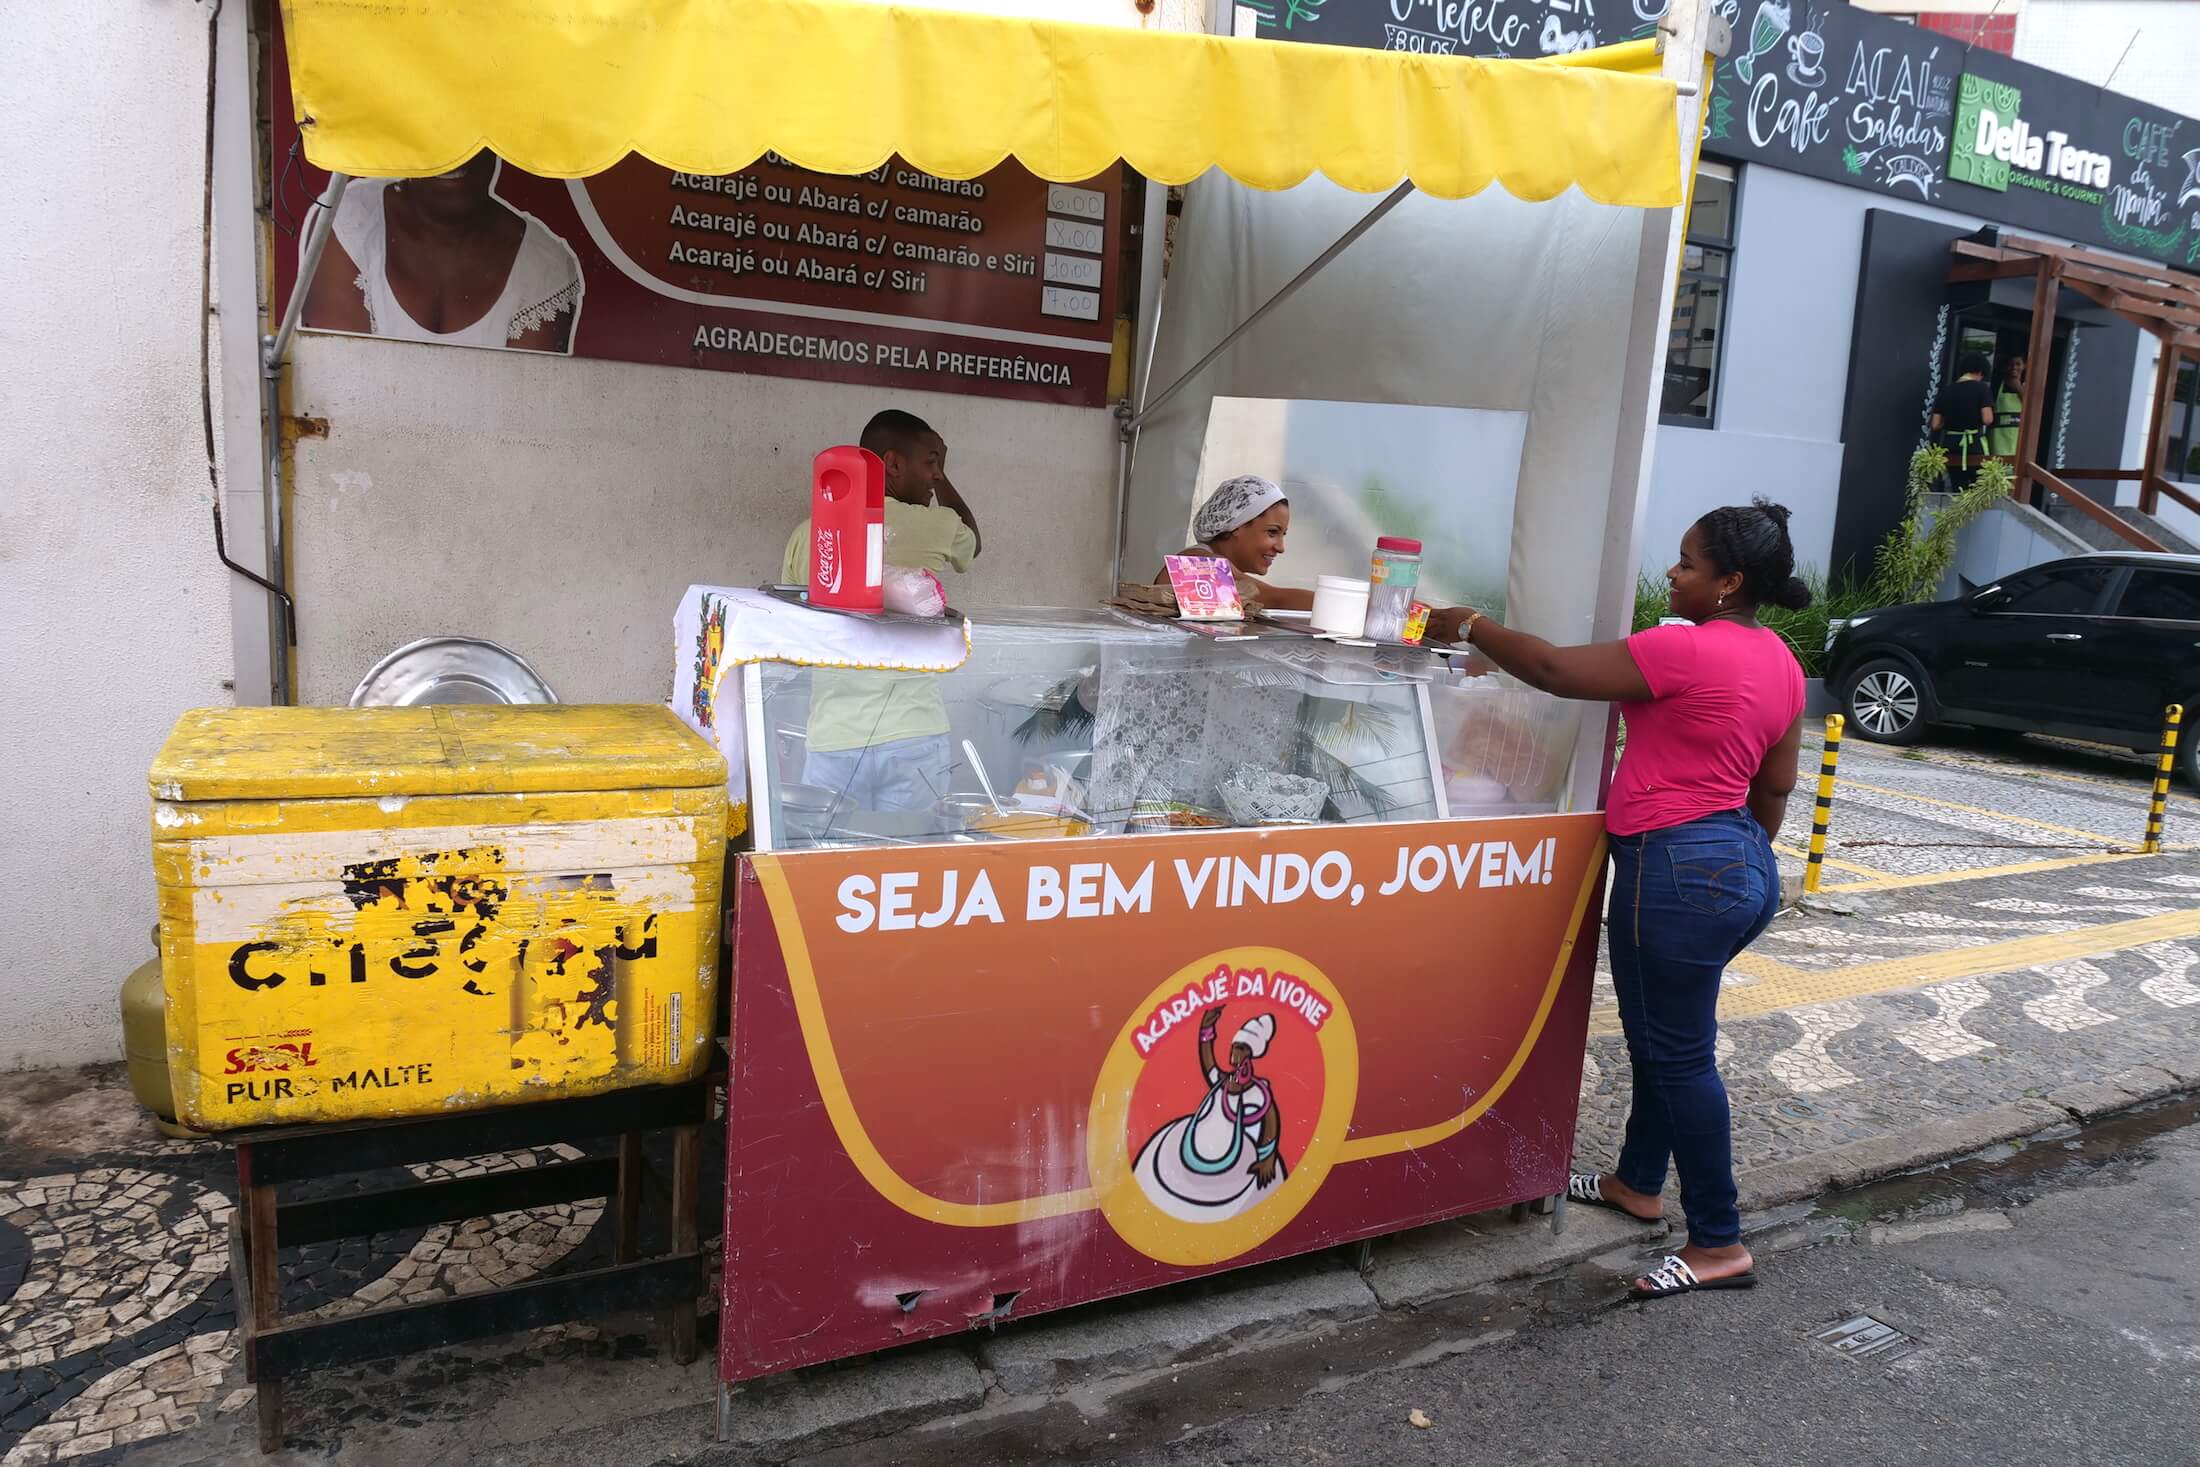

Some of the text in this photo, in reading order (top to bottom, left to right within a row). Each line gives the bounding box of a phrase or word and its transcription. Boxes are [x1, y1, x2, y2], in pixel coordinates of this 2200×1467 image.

[1390, 0, 1530, 47] elete
[1845, 40, 1940, 109] AÇAÍ
[1747, 73, 1840, 153] Café
[1845, 102, 1946, 155] Saladas
[2122, 117, 2183, 168] CAFÉ
[1974, 108, 2112, 189] Della Terra
[671, 172, 982, 232] Acarajé ou Abará c/ camarão
[2009, 170, 2104, 205] ORGANIC & GOURMET
[669, 241, 926, 292] Acarajé ou Abará c/ Siri
[670, 204, 1036, 275] Acarajé ou Abará c/ camarão e Siri
[693, 325, 1072, 386] AGRADECEMOS PELA PREFERÊNCIA
[835, 838, 1557, 933] SEJA BEM VINDO, JOVEM!
[1136, 970, 1328, 1053] ACARAJÉ DA IVONE
[332, 1063, 433, 1093] MALTE
